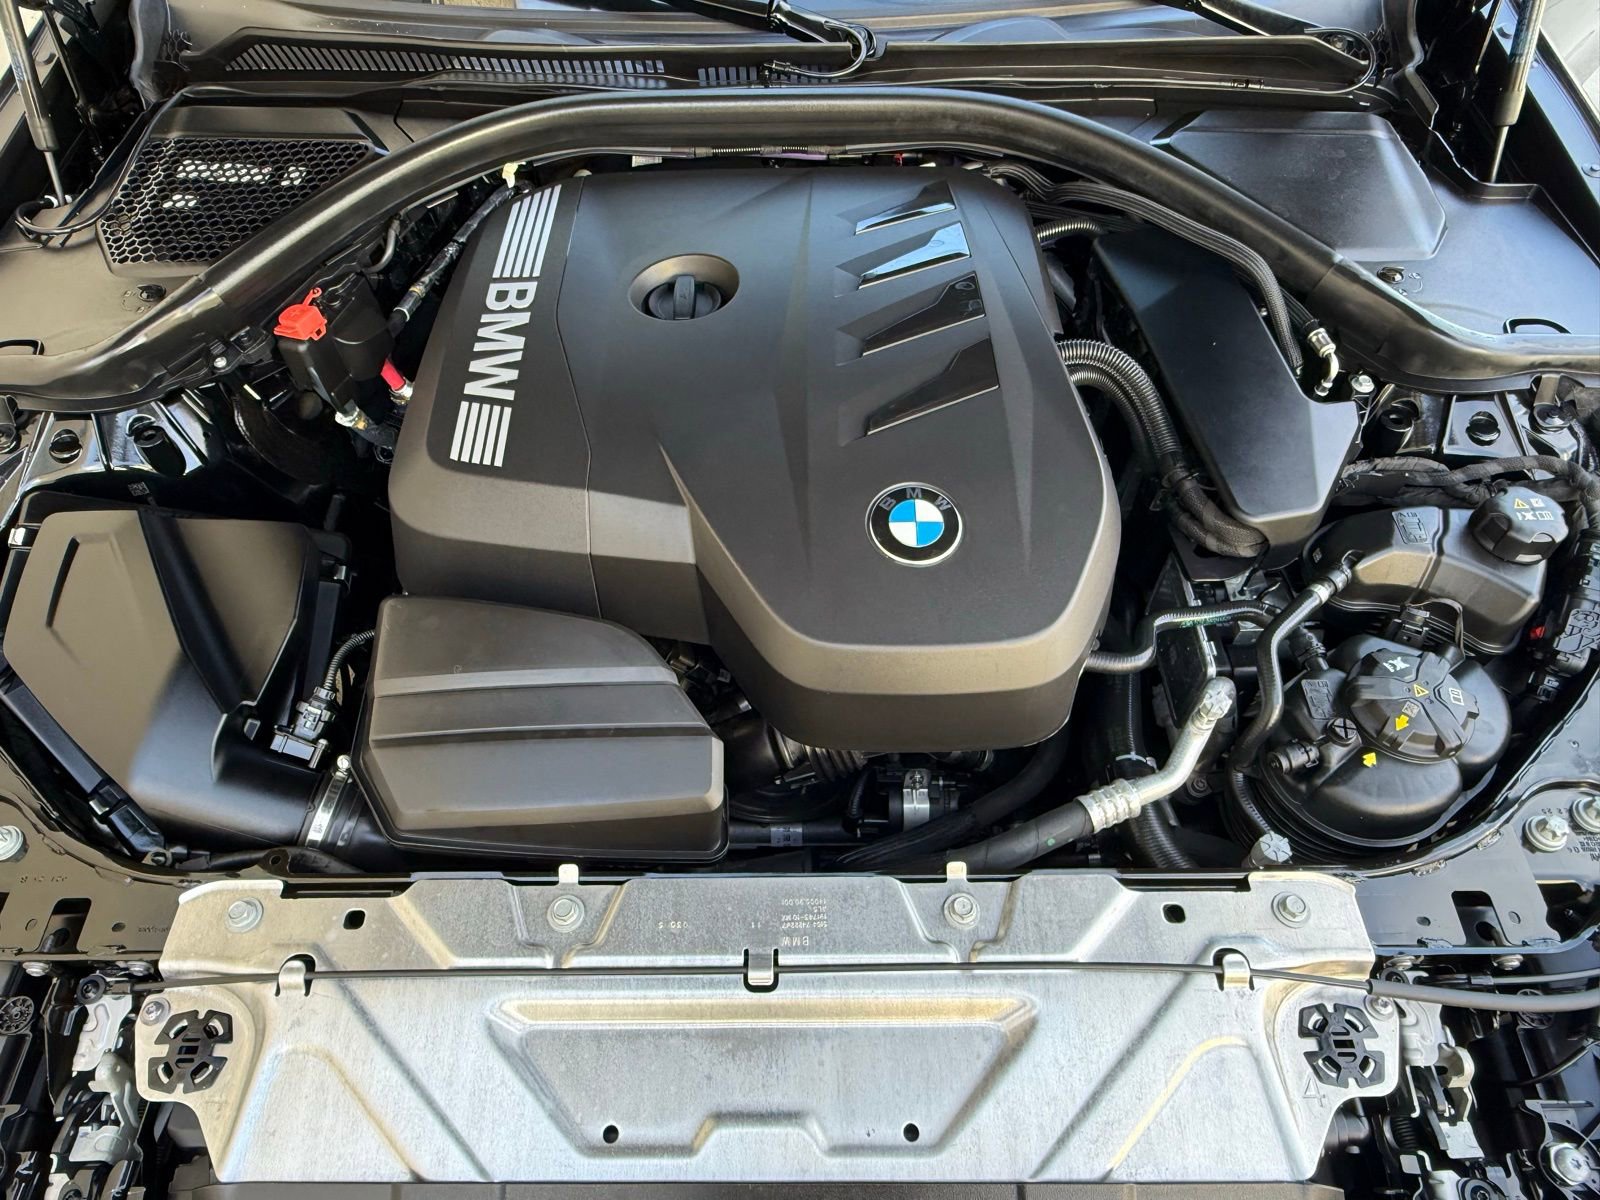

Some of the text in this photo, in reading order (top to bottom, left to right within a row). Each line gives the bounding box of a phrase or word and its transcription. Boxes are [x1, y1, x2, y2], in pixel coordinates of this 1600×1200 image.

[463, 281, 538, 400] BMW
[879, 487, 952, 511] BMW
[781, 935, 809, 946] BMW
